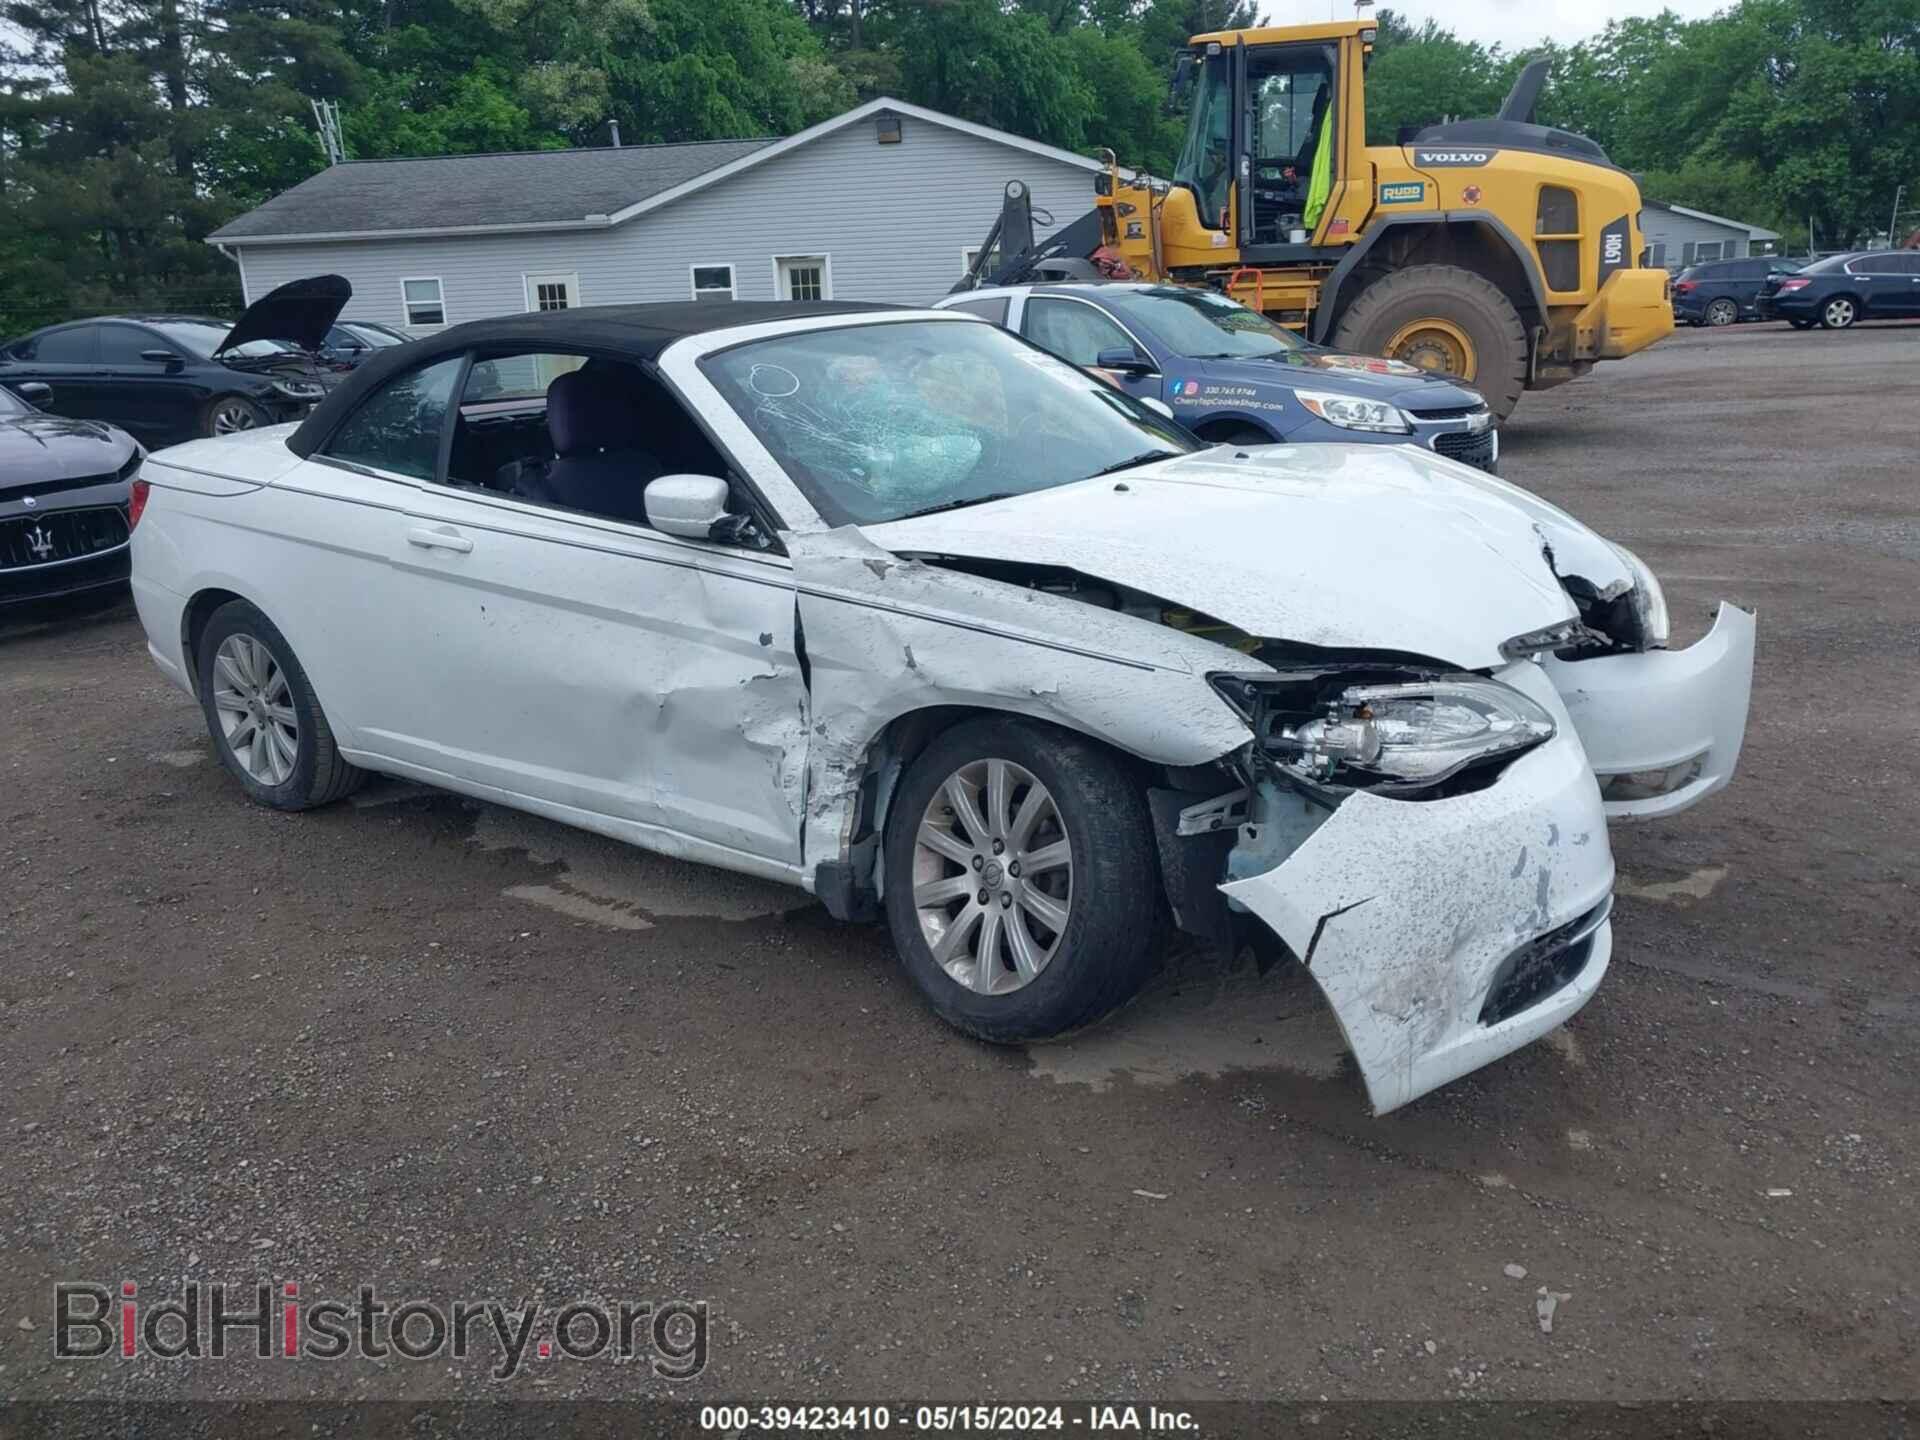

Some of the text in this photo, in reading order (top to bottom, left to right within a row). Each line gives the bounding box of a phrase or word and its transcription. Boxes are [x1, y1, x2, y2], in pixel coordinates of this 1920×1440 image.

[1421, 153, 1487, 162] VOLVO
[1383, 186, 1421, 200] RUDD
[1604, 234, 1622, 264] L90H
